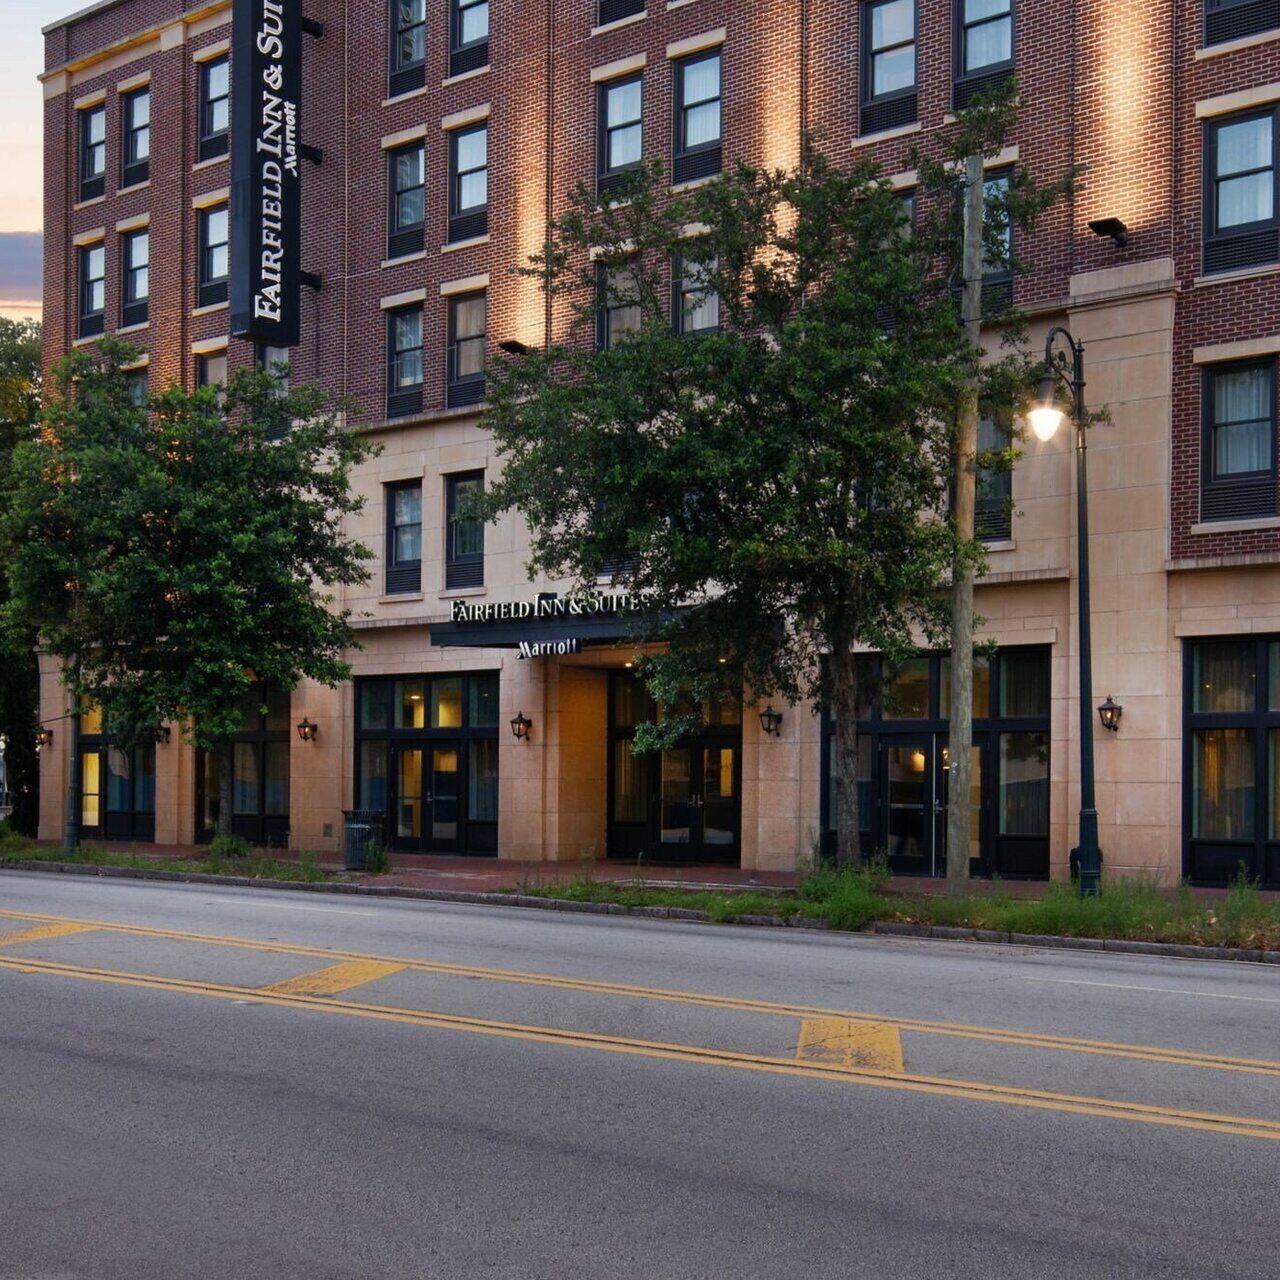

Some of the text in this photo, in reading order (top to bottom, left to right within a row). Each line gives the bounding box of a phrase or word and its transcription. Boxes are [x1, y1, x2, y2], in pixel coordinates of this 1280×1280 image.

[263, 64, 283, 91] &
[256, 90, 282, 159] INN
[283, 101, 298, 177] Marriott
[255, 161, 282, 323] FAIRFIELD
[449, 599, 530, 622] FAIRFIELD
[533, 593, 566, 617] INN
[569, 599, 584, 615] &
[516, 638, 577, 660] Marriott
